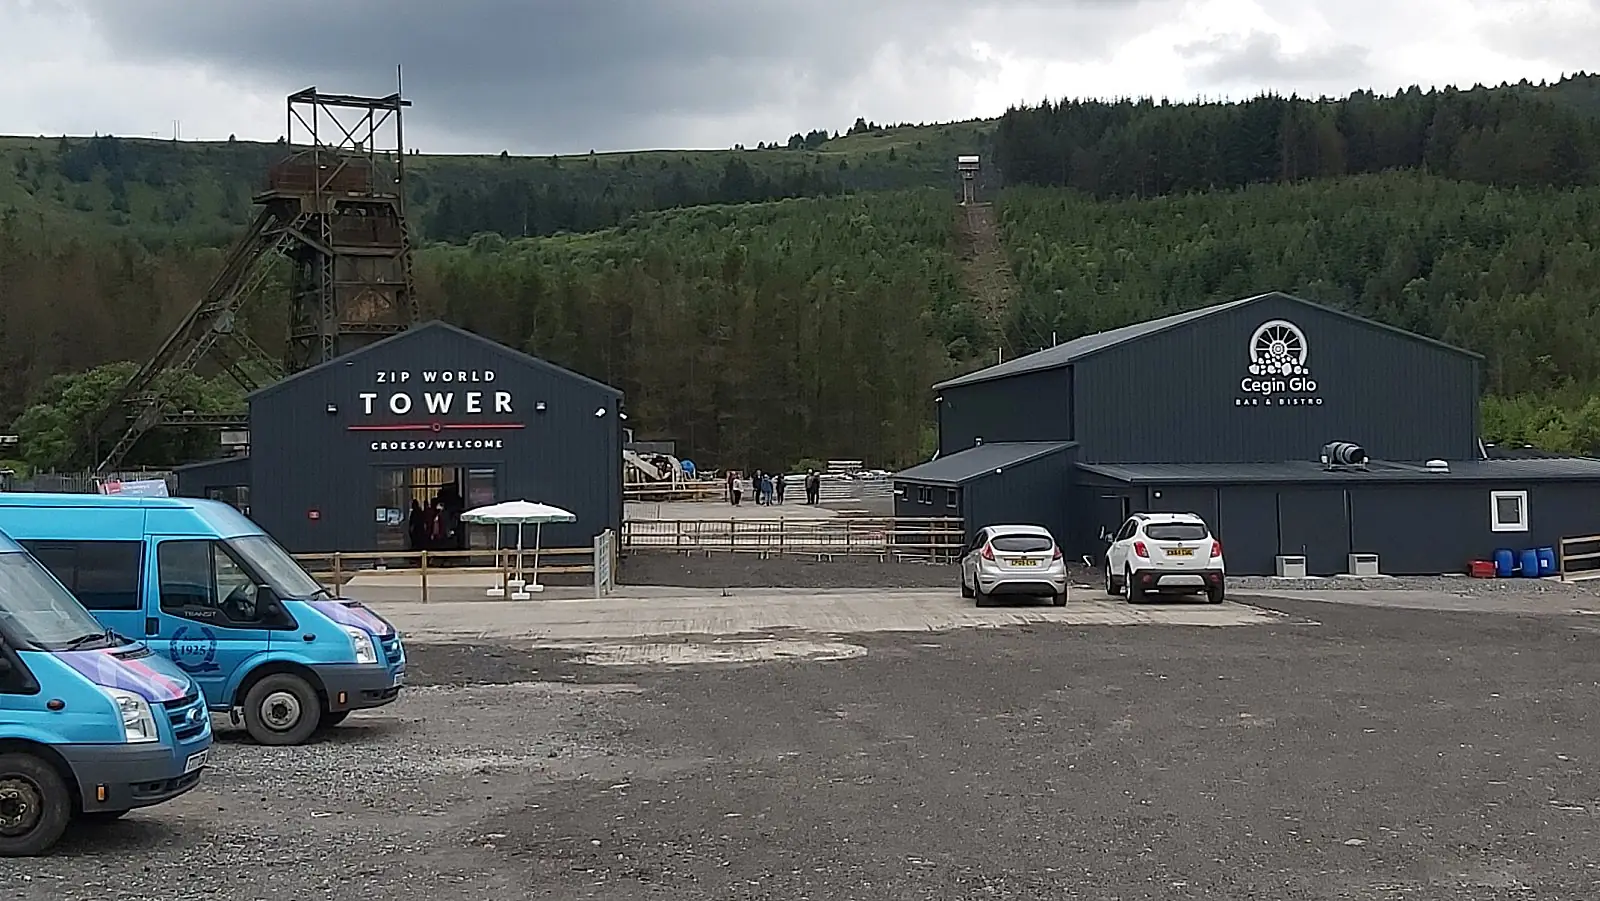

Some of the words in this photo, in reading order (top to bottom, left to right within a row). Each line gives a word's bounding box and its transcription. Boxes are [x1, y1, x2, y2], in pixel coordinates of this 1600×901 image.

[376, 371, 411, 383] ZIP
[423, 370, 496, 383] WORLD
[1241, 377, 1285, 395] Cegin
[1289, 377, 1317, 391] Glo
[359, 391, 513, 414] TOWER
[1235, 398, 1258, 406] BAR
[1279, 398, 1323, 406] BISTRO
[371, 440, 504, 450] CROESO/WELCOME
[181, 645, 206, 655] 1925
